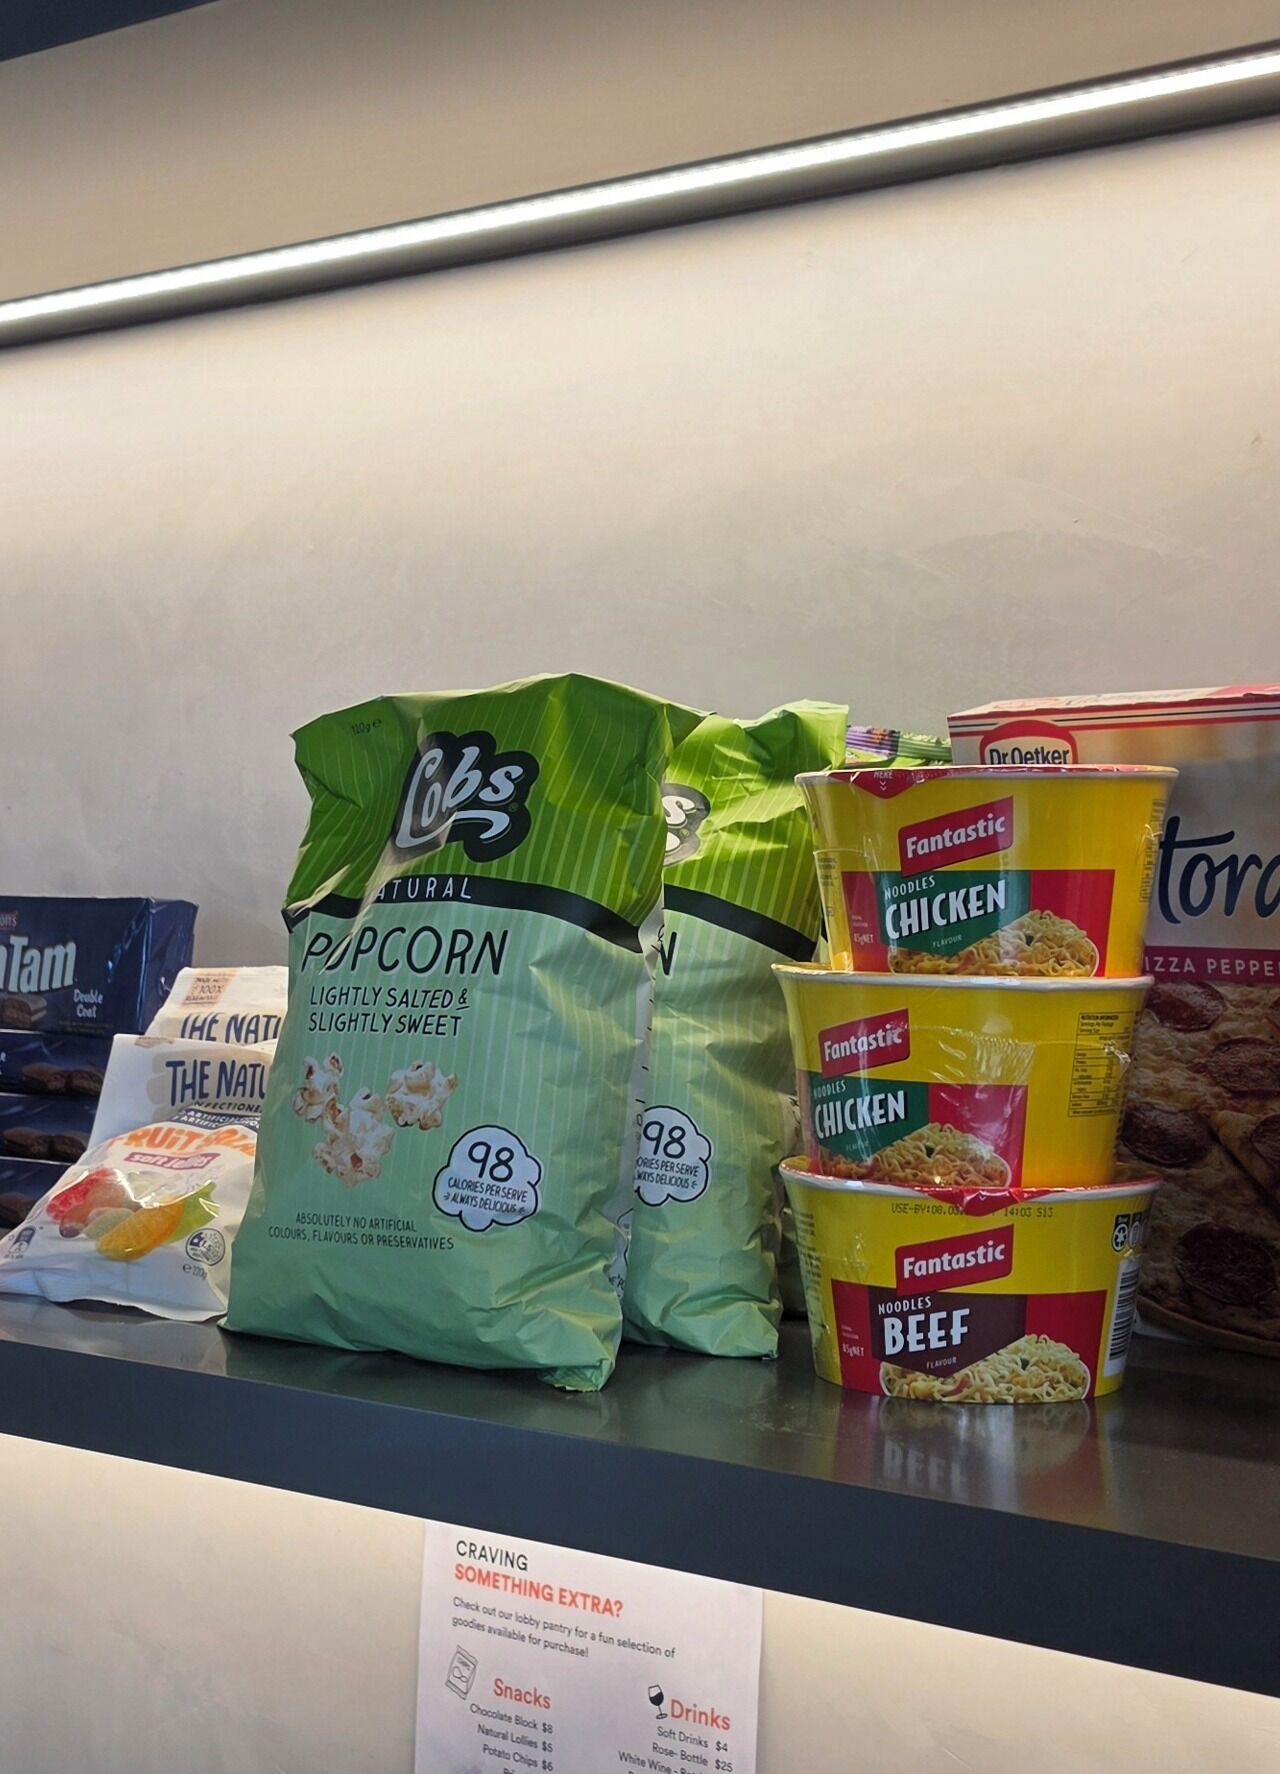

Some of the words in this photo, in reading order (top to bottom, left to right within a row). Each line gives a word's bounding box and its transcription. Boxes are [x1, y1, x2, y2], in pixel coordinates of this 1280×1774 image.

[395, 745, 524, 849] Cobs
[906, 814, 1007, 859] Fantastic
[884, 874, 936, 900] NOODLES
[885, 880, 1007, 940] CHICKEN
[301, 926, 509, 976] POPCORN
[73, 988, 103, 1005] Double
[76, 1003, 98, 1019] Coat
[309, 985, 382, 1009] LIGHTLY
[384, 986, 455, 1009] SALTED
[456, 987, 470, 1010] &
[308, 1011, 393, 1036] SLIGHTLY
[395, 1013, 463, 1037] SWEET
[823, 1023, 904, 1062] Fantastic
[165, 1060, 211, 1107] THE
[815, 1090, 905, 1141] CHICKEN
[642, 1120, 687, 1159] 98
[467, 1141, 515, 1183] 98
[659, 1159, 676, 1173] PER
[675, 1161, 701, 1178] SERVE
[447, 1176, 487, 1196] CALORIES
[485, 1182, 501, 1197] PER
[500, 1185, 528, 1203] SERVE
[451, 1192, 480, 1208] ALWAYS
[479, 1198, 518, 1214] DELICIOUS
[268, 1226, 310, 1243] COLOURS,
[312, 1230, 359, 1245] FLAVOURS
[360, 1233, 375, 1246] OR
[376, 1234, 455, 1250] PRESERVATIVES
[295, 1212, 351, 1228] ABSOLUTELY
[354, 1216, 366, 1229] NO
[369, 1217, 417, 1232] ARTIFICIAL
[902, 1240, 1007, 1279] Fantastic
[878, 1295, 933, 1315] NOODLES
[884, 1308, 971, 1356] BEEF
[925, 1356, 958, 1369] FLAVOUR
[455, 1539, 529, 1572] CRAVING
[454, 1562, 554, 1603] SOMETHING
[558, 1588, 624, 1618] EXTRA?
[451, 1615, 486, 1633] goodies
[487, 1624, 526, 1643] available
[527, 1633, 542, 1646] for
[542, 1638, 589, 1658] purchase!
[452, 1595, 481, 1613] Check
[482, 1605, 497, 1616] out
[498, 1609, 513, 1620] our
[514, 1611, 541, 1631] lobby
[542, 1620, 573, 1636] pantry
[574, 1626, 588, 1639] for
[589, 1632, 597, 1642] a
[598, 1632, 615, 1646] fun
[616, 1636, 662, 1656] selection
[663, 1647, 676, 1659] of
[493, 1677, 552, 1711] Snacks
[470, 1702, 513, 1724] Chocolate
[514, 1714, 539, 1731] Block
[541, 1721, 554, 1735] $8
[670, 1699, 731, 1731] Drinks
[477, 1723, 509, 1741] Natural
[510, 1732, 539, 1750] Lollies
[541, 1740, 554, 1753] $5
[657, 1726, 677, 1741] Soft
[678, 1731, 709, 1749] Drinks
[715, 1741, 729, 1753] $4
[482, 1743, 511, 1761] Potato
[512, 1751, 539, 1768] Chips
[541, 1758, 555, 1772] $6
[618, 1750, 647, 1769] White
[647, 1758, 673, 1774] Wine
[679, 1750, 709, 1767] Bottle
[714, 1758, 734, 1773] $25
